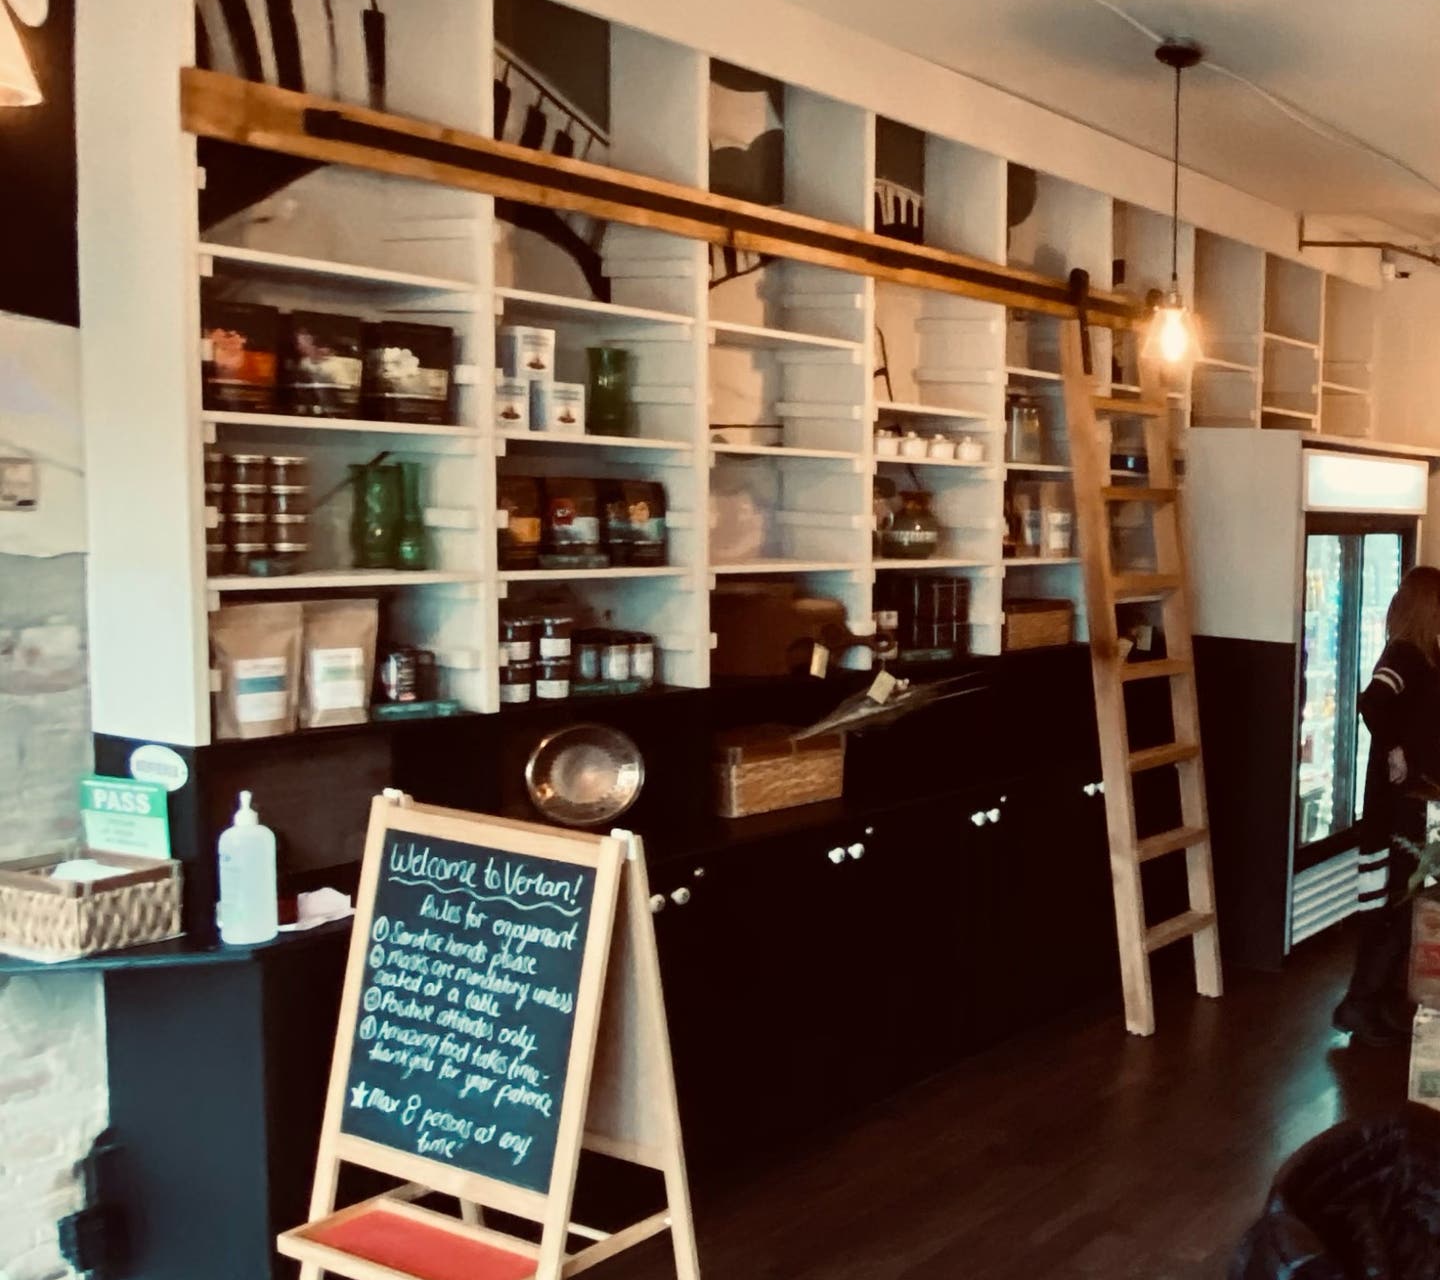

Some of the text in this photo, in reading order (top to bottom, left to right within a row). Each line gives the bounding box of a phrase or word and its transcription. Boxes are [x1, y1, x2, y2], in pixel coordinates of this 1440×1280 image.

[93, 788, 152, 815] PASS
[391, 843, 477, 888] Welcome
[485, 857, 501, 889] to
[464, 901, 488, 930] for
[424, 979, 444, 997] at
[448, 987, 460, 1003] a
[465, 988, 501, 1017] table
[438, 1032, 471, 1063] food
[498, 1025, 538, 1061] only
[401, 1094, 422, 1125] 8
[417, 1108, 474, 1139] persons
[474, 1124, 497, 1144] at
[499, 1131, 533, 1165] any
